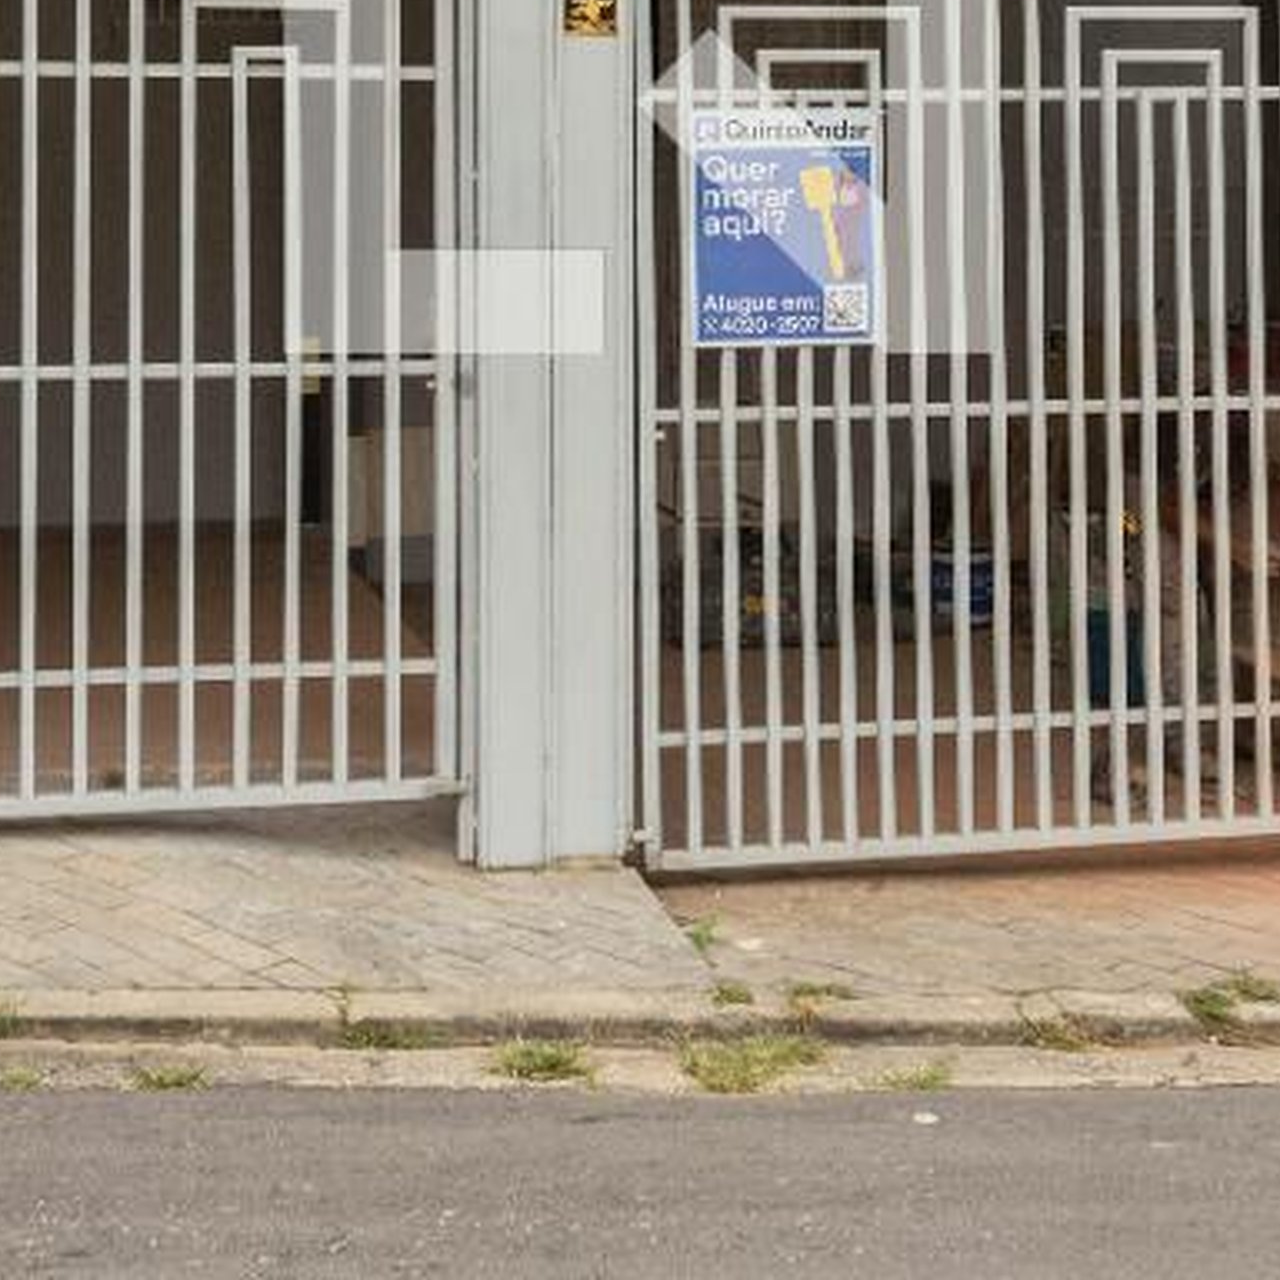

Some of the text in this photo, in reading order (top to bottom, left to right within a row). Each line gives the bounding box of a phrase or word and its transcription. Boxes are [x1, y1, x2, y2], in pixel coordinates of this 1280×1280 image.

[702, 156, 781, 183] Quer
[703, 186, 796, 208] morar
[703, 210, 786, 241] aqui?
